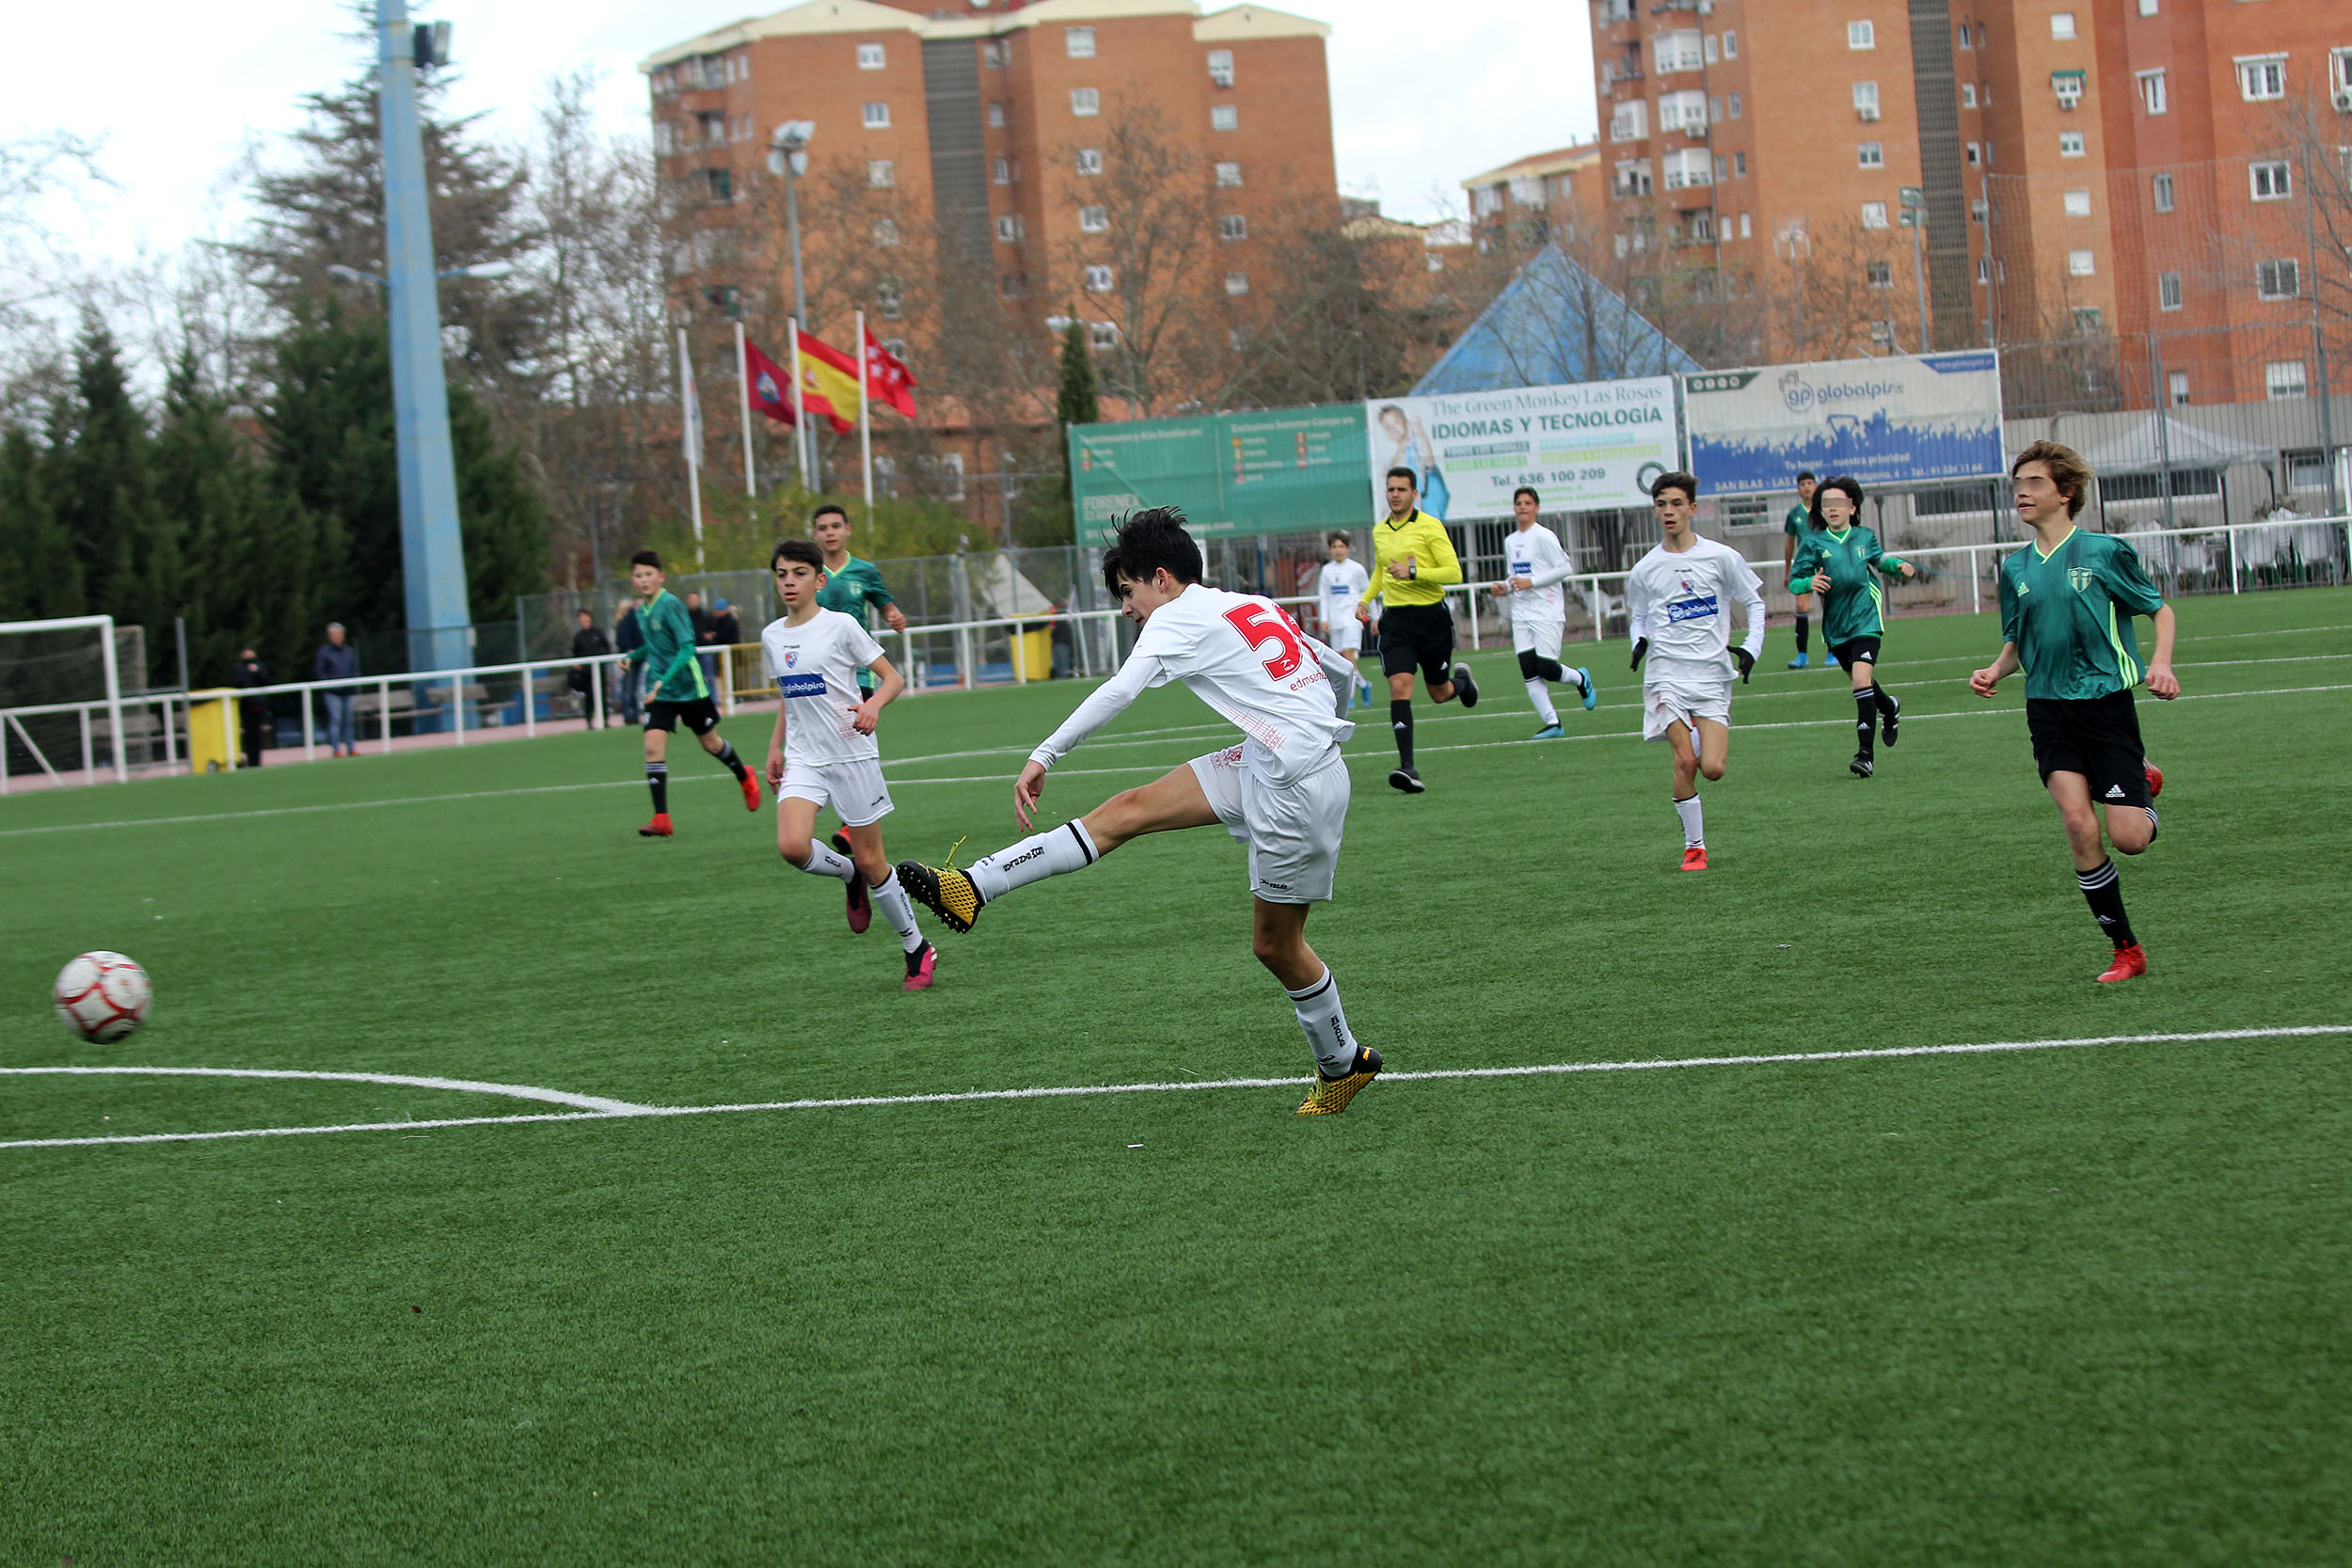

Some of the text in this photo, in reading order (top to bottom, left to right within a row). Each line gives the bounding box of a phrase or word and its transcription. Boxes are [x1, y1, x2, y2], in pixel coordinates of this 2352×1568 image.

[1431, 385, 1662, 417] The Green Monkey Las Rosas
[1431, 405, 1662, 439] IDIOMAS Y TECNOLOGÍA
[1491, 467, 1605, 486] Tel. 636 100 209
[1715, 481, 1737, 491] SAN
[1739, 479, 1763, 490] BLAS
[1772, 476, 1791, 487] LAS
